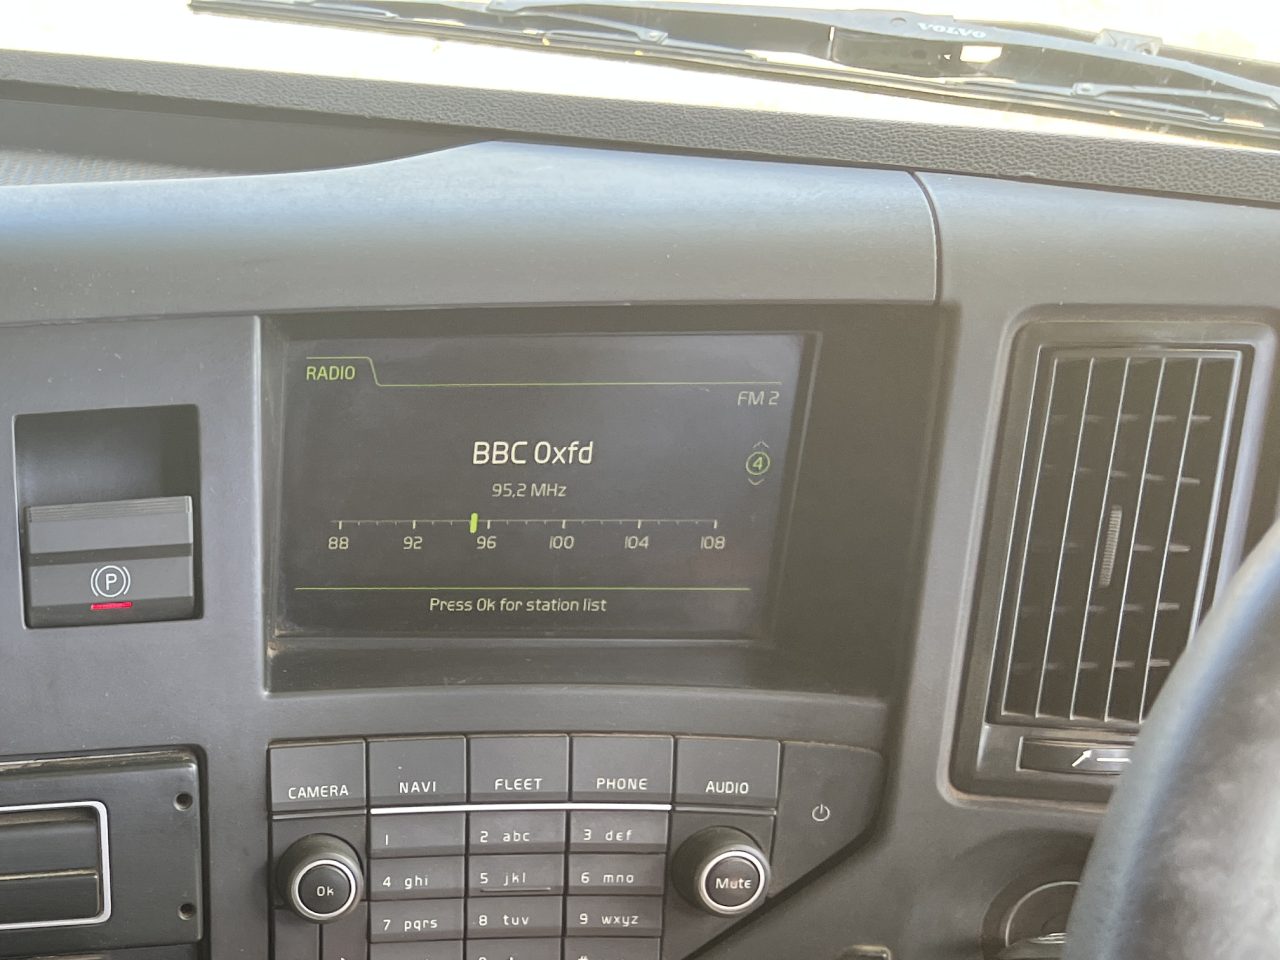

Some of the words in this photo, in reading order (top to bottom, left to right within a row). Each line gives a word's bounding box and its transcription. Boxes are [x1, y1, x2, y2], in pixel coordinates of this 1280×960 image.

[917, 22, 986, 38] VOLVO
[307, 366, 355, 380] RADIO
[473, 441, 527, 464] BBC
[535, 441, 593, 463] Oxfd
[753, 457, 763, 470] 4
[531, 484, 566, 496] MHz
[329, 537, 348, 549] 88
[404, 536, 422, 549] 92
[477, 536, 496, 549] 96
[550, 536, 574, 549] 100
[625, 536, 648, 549] 104
[701, 536, 725, 549] 108
[105, 573, 118, 590] P
[430, 598, 472, 611] Press
[477, 598, 495, 611] Ok
[501, 598, 522, 611] for
[527, 598, 579, 611] station
[583, 599, 606, 611] list
[400, 782, 435, 793] NAVI
[495, 779, 542, 790] FLEET
[597, 778, 647, 790] PHONE
[706, 781, 748, 794] AUDIO
[289, 785, 348, 799] CAMERA
[481, 831, 488, 842] 2
[503, 831, 529, 841] abc
[584, 829, 591, 840] 3
[606, 830, 632, 840] def
[383, 877, 391, 887] 4
[405, 876, 427, 889] ghi
[481, 873, 488, 883] 5
[504, 873, 525, 886] jkl
[582, 872, 589, 883] 6
[603, 875, 633, 883] mno
[716, 878, 751, 889] Mute
[317, 886, 334, 896] Ok
[384, 920, 390, 930] 7
[405, 920, 437, 931] pqrs
[479, 915, 487, 925] 8
[504, 915, 528, 925] tuv
[580, 914, 587, 924] 9
[602, 916, 638, 926] wxyz
